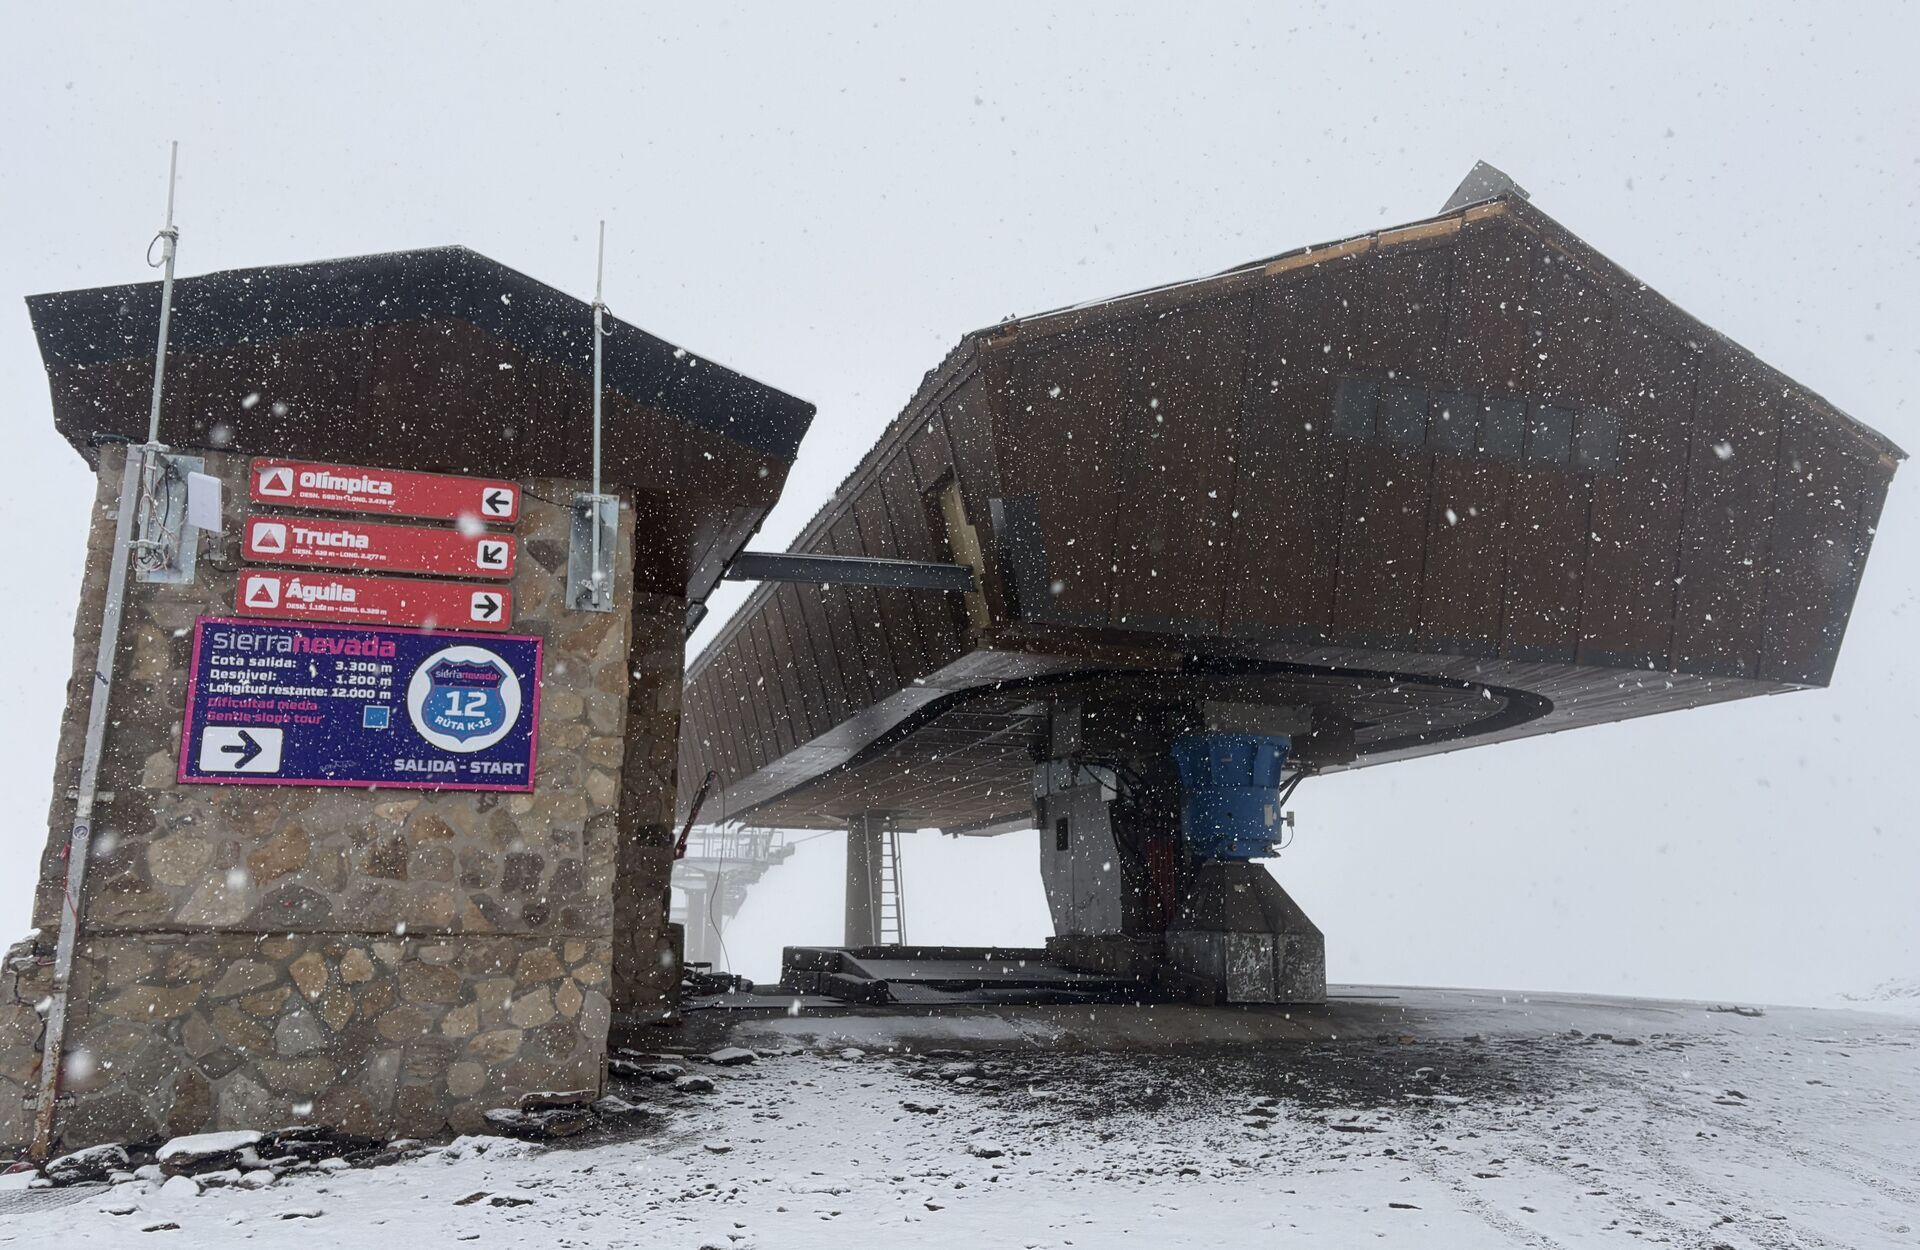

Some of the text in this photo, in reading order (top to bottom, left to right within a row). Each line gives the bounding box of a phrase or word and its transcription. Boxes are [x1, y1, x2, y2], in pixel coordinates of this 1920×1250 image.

[300, 471, 392, 495] Olímpica
[292, 528, 369, 549] Trucha
[285, 577, 356, 602] Águila
[212, 632, 396, 657] sierranevada
[211, 655, 392, 673] Cota salida: 3.300 m
[210, 669, 392, 686] Desnivel: 1.200 m
[435, 669, 497, 681] sierranevada
[209, 683, 392, 699] Longitud restante: 12.000 m
[208, 697, 318, 711] Dificultad media
[444, 690, 487, 717] 12
[294, 715, 322, 725] tour
[434, 715, 492, 731] RUTA K-12
[394, 758, 456, 773] SALIDA
[470, 761, 524, 775] START
